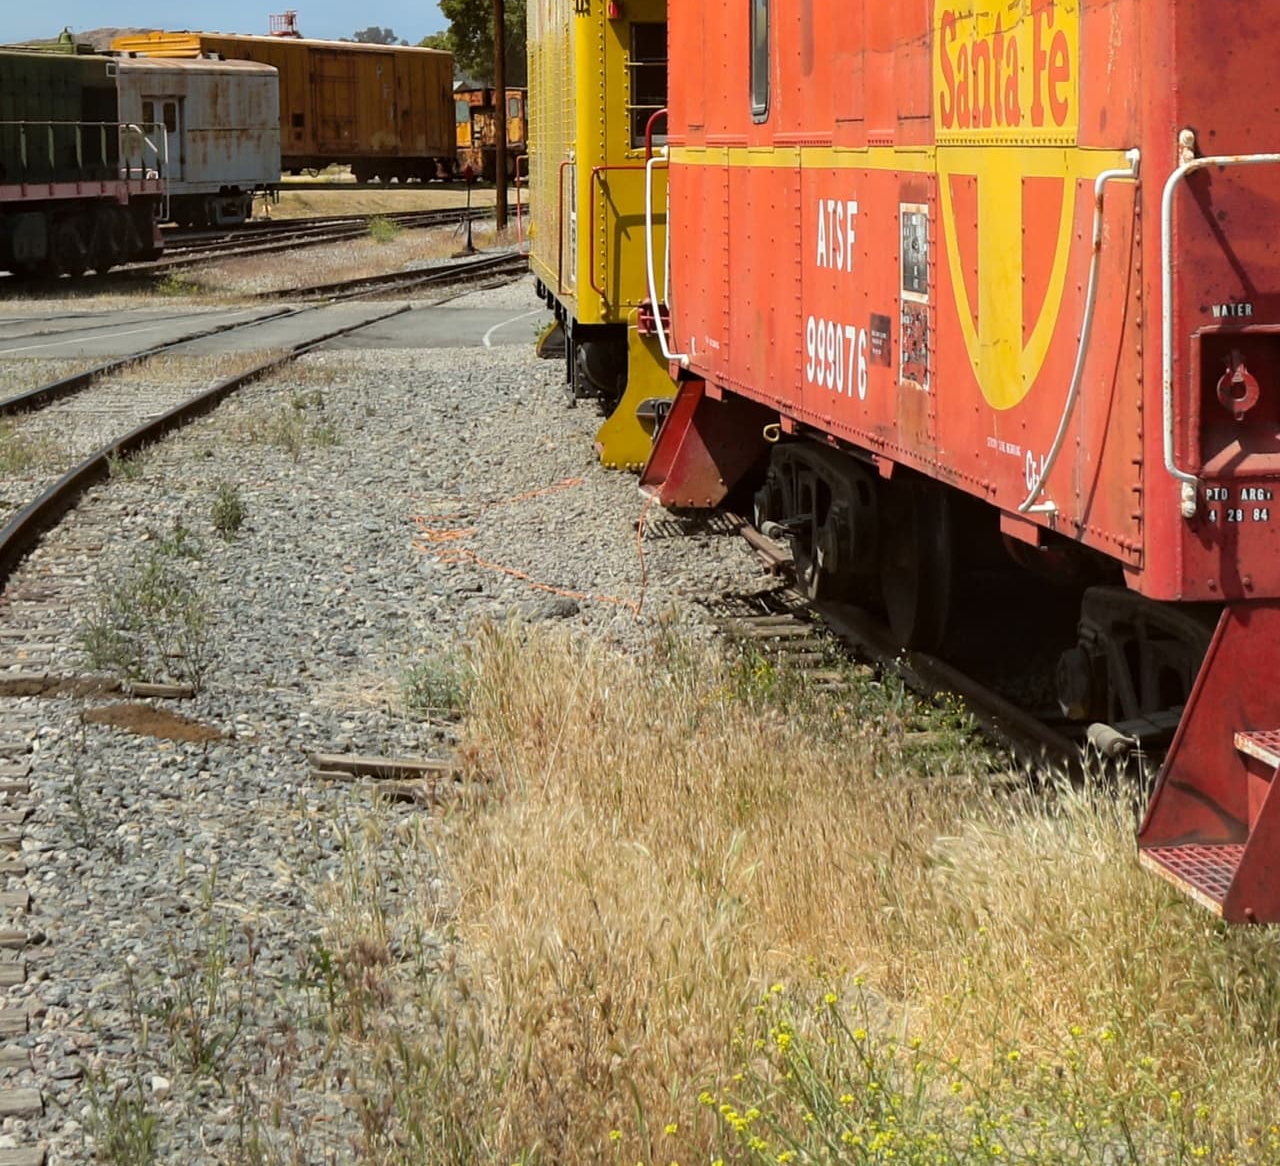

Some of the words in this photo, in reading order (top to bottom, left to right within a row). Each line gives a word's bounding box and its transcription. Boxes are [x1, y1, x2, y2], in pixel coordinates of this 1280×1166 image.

[940, 9, 1020, 130] Santa
[816, 198, 859, 273] ATSF
[1211, 303, 1253, 318] WATER
[806, 315, 868, 401] 999076
[1206, 488, 1229, 501] PTD
[1253, 507, 1268, 522] 84
